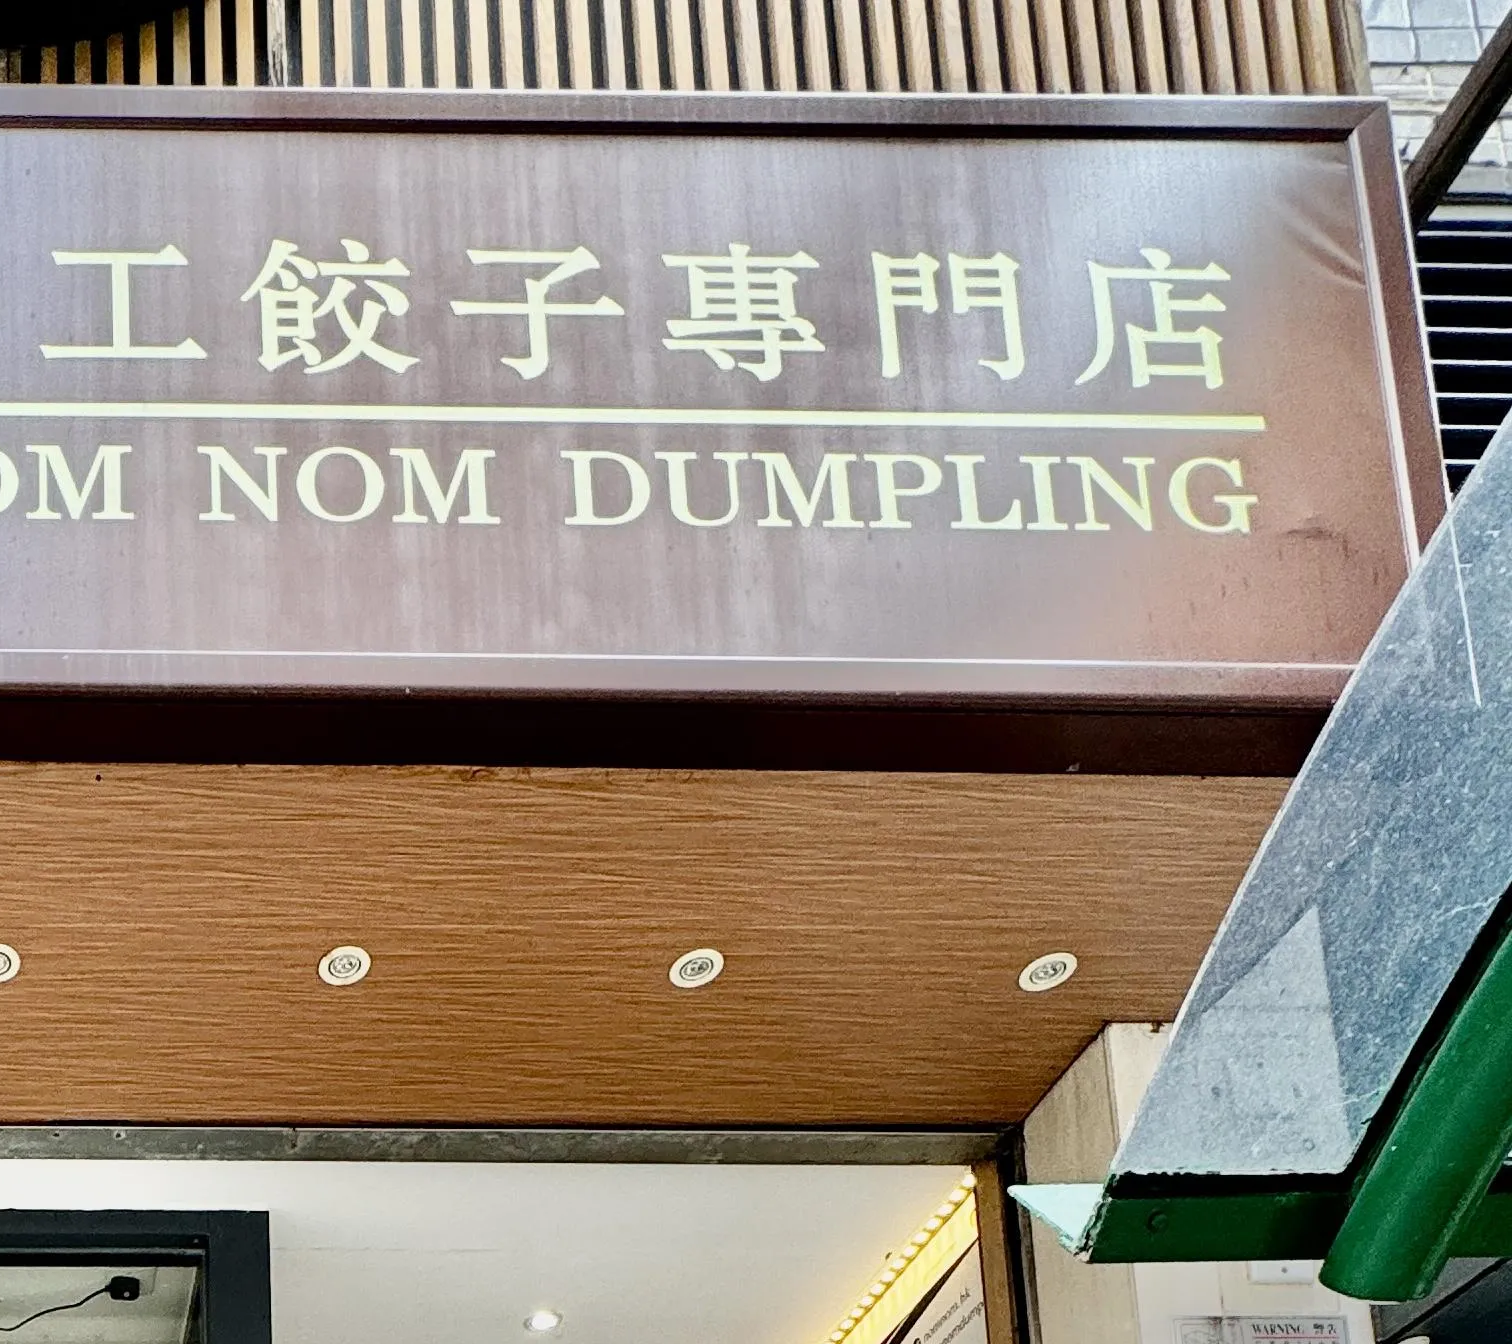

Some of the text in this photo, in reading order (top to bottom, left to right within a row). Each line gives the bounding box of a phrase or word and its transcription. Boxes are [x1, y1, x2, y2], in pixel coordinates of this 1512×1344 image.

[199, 440, 500, 532] NOM
[563, 446, 1258, 540] DUMPLING
[1252, 1324, 1305, 1335] WARNING
